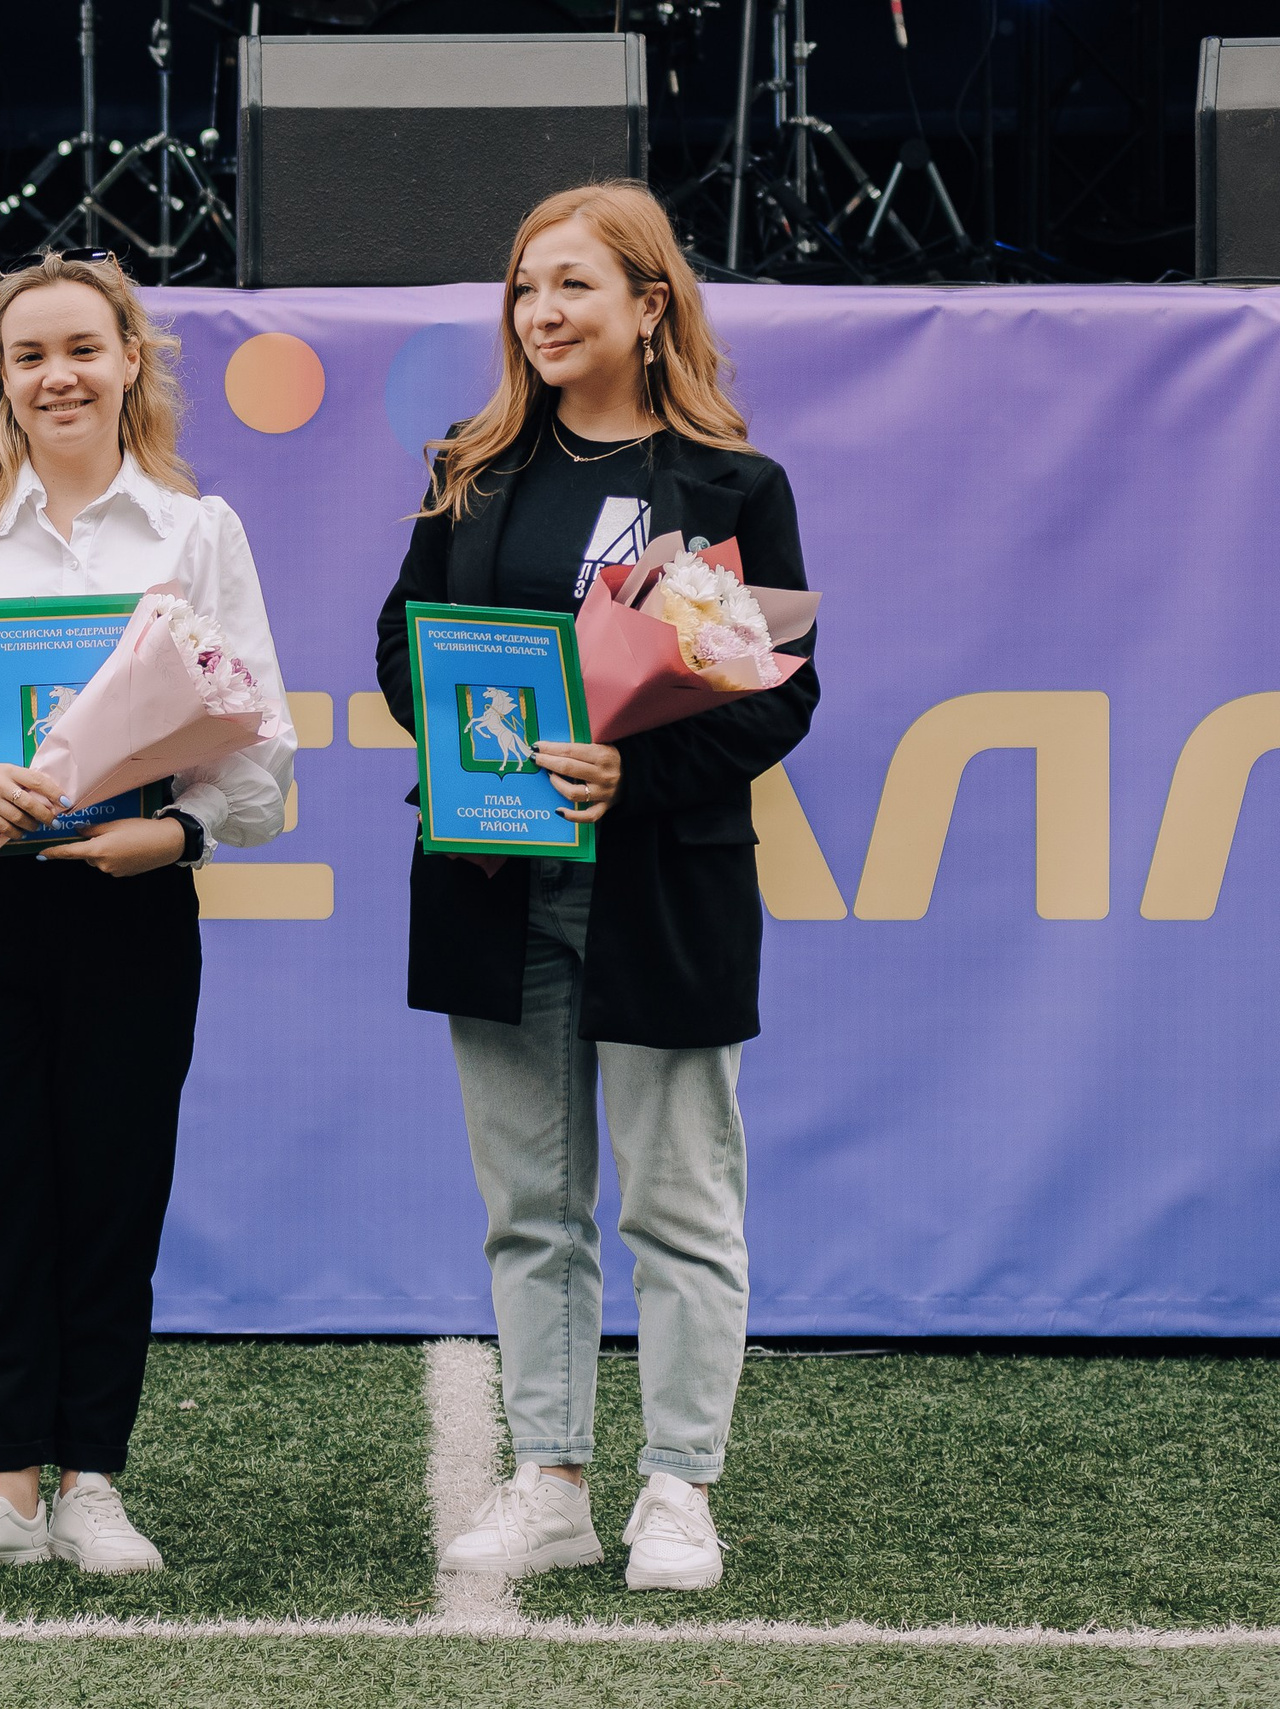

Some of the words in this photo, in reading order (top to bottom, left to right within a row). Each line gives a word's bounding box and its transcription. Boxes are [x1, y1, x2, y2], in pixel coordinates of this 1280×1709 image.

[65, 626, 125, 637] ФЕДЕРАЦИЯ
[428, 630, 492, 641] РОССИЙСКАЯ
[493, 633, 550, 645] ФЕДЕРАЦИЯ
[0, 640, 73, 652] ЧЕЛЯБИНСКАЯ
[433, 642, 502, 654] ЧЕЛЯБИНСКАЯ
[504, 645, 548, 657] ОБЛАСТЬ
[484, 794, 522, 806] ГЛАВА
[456, 807, 551, 821] СОСНОВСКОГО
[479, 820, 529, 833] РАЙОНА
